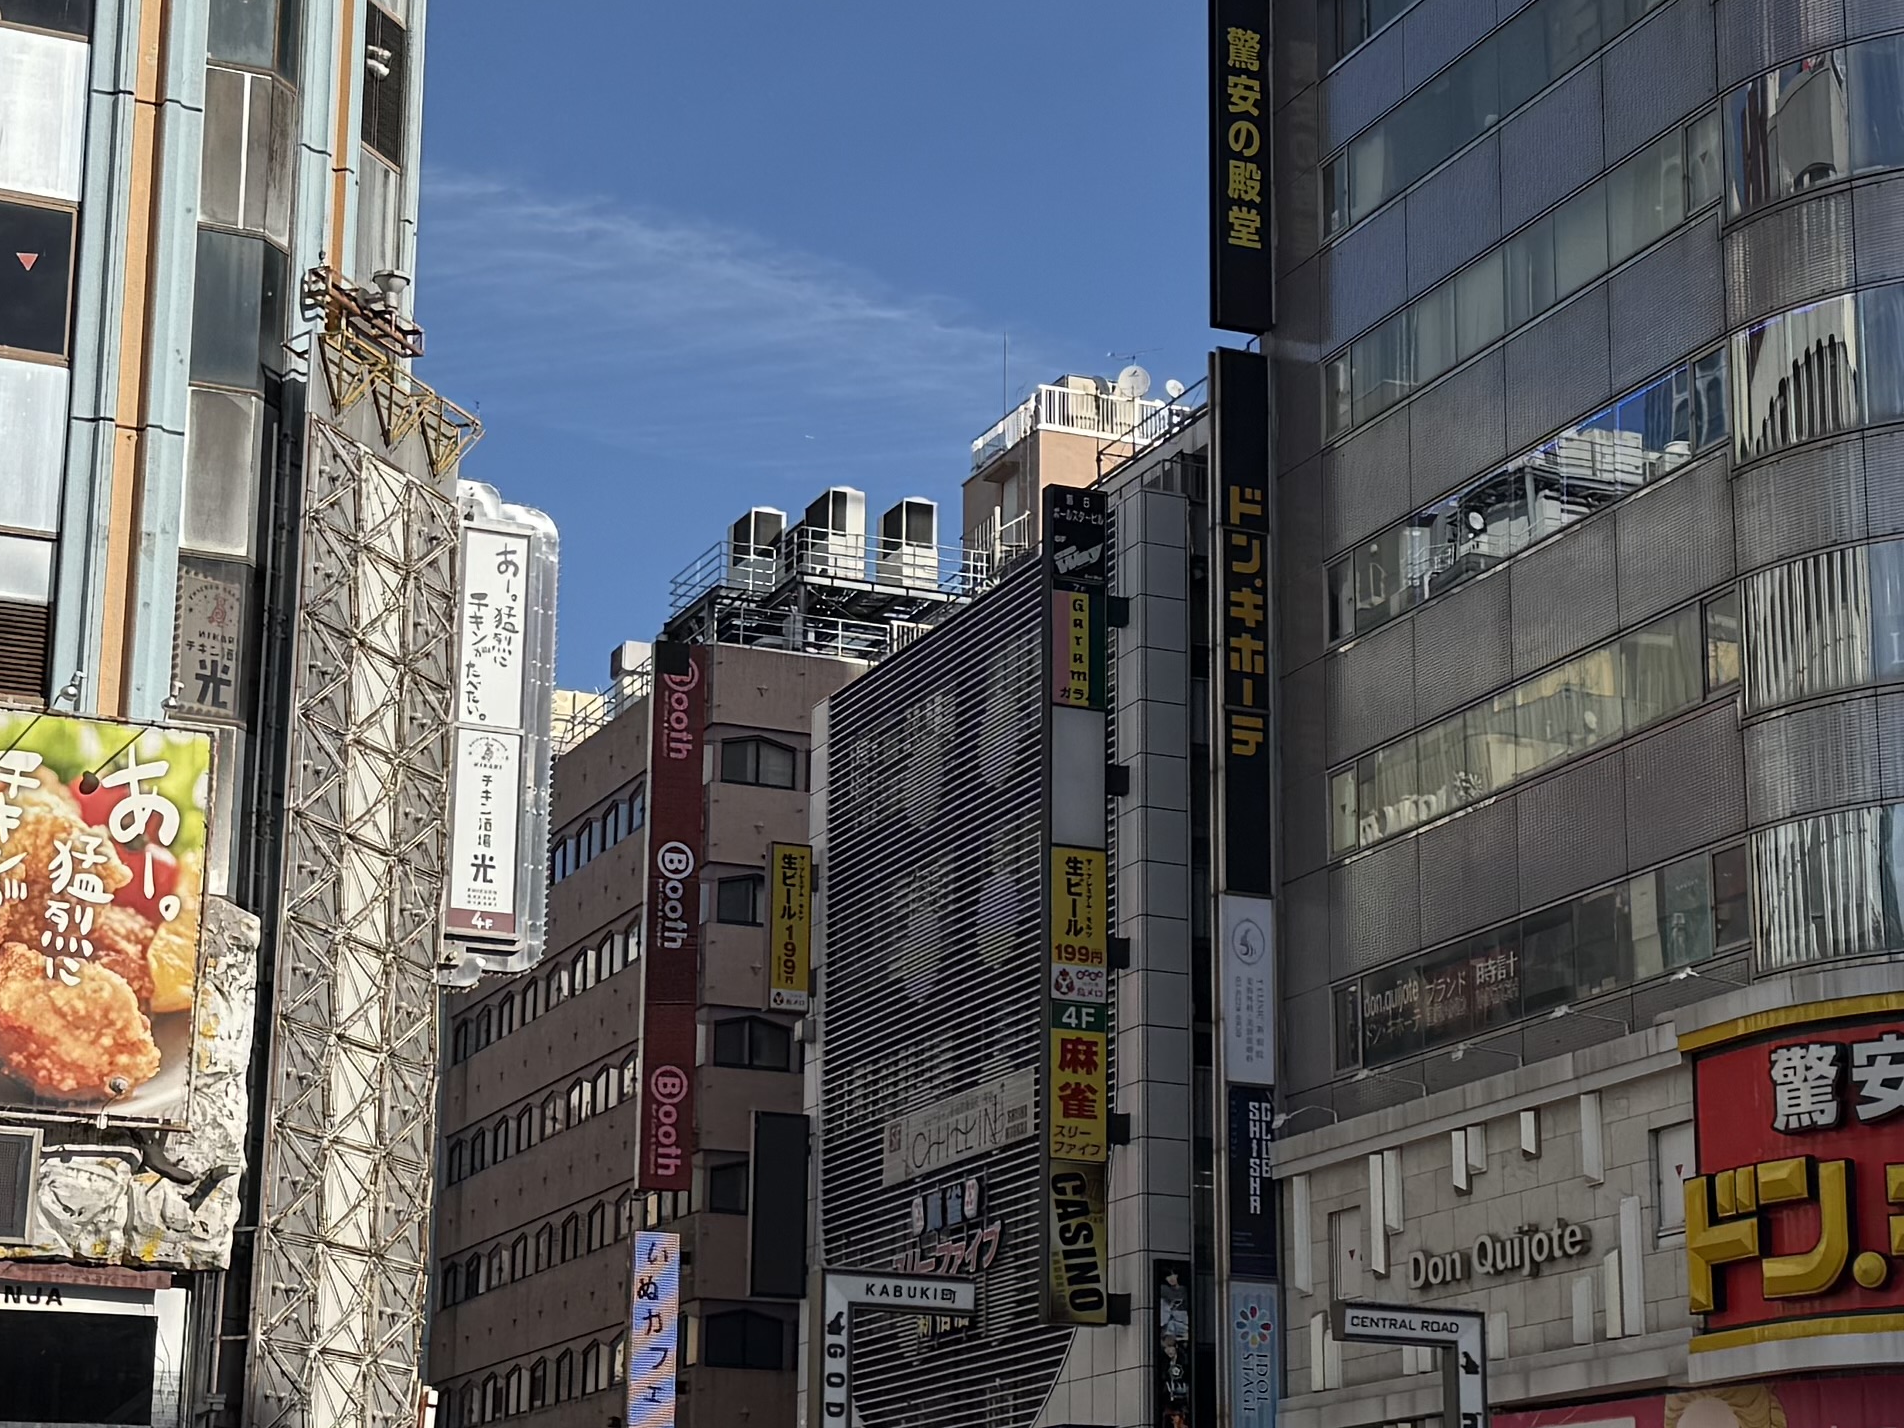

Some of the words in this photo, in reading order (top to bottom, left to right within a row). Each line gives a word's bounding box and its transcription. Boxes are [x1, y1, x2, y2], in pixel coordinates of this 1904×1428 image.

[1227, 26, 1262, 250] 驚安の殿堂
[467, 592, 492, 659] チキンが
[493, 606, 520, 669] 猛烈に
[1069, 598, 1087, 682] Garam
[194, 658, 232, 710] 光
[106, 744, 182, 925] あー。
[477, 774, 494, 849] チキン酒場
[470, 853, 497, 884] 光
[656, 839, 695, 951] Booth
[780, 852, 799, 920] 生ビール
[1064, 856, 1084, 937] 生ビール
[42, 833, 116, 986] 猛烈に
[471, 911, 494, 930] 4F
[1054, 943, 1103, 964] 199円
[1424, 970, 1467, 1004] ブランド
[1475, 951, 1520, 986] 時計
[1061, 1006, 1095, 1029] 4F
[1057, 1036, 1100, 1121] 麻雀
[650, 1064, 688, 1178] Booth
[1053, 1125, 1092, 1140] スリー
[1247, 1101, 1261, 1215] SHISHA
[1050, 1173, 1106, 1313] CASINO
[1407, 1247, 1471, 1291] Don
[1472, 1217, 1592, 1278] Quijote
[636, 1240, 671, 1406] いぬカフェ
[864, 1280, 959, 1305] KABUKI町
[1350, 1315, 1418, 1332] CENTRAL
[1420, 1319, 1461, 1335] ROAD
[1256, 1352, 1270, 1405] IDOL
